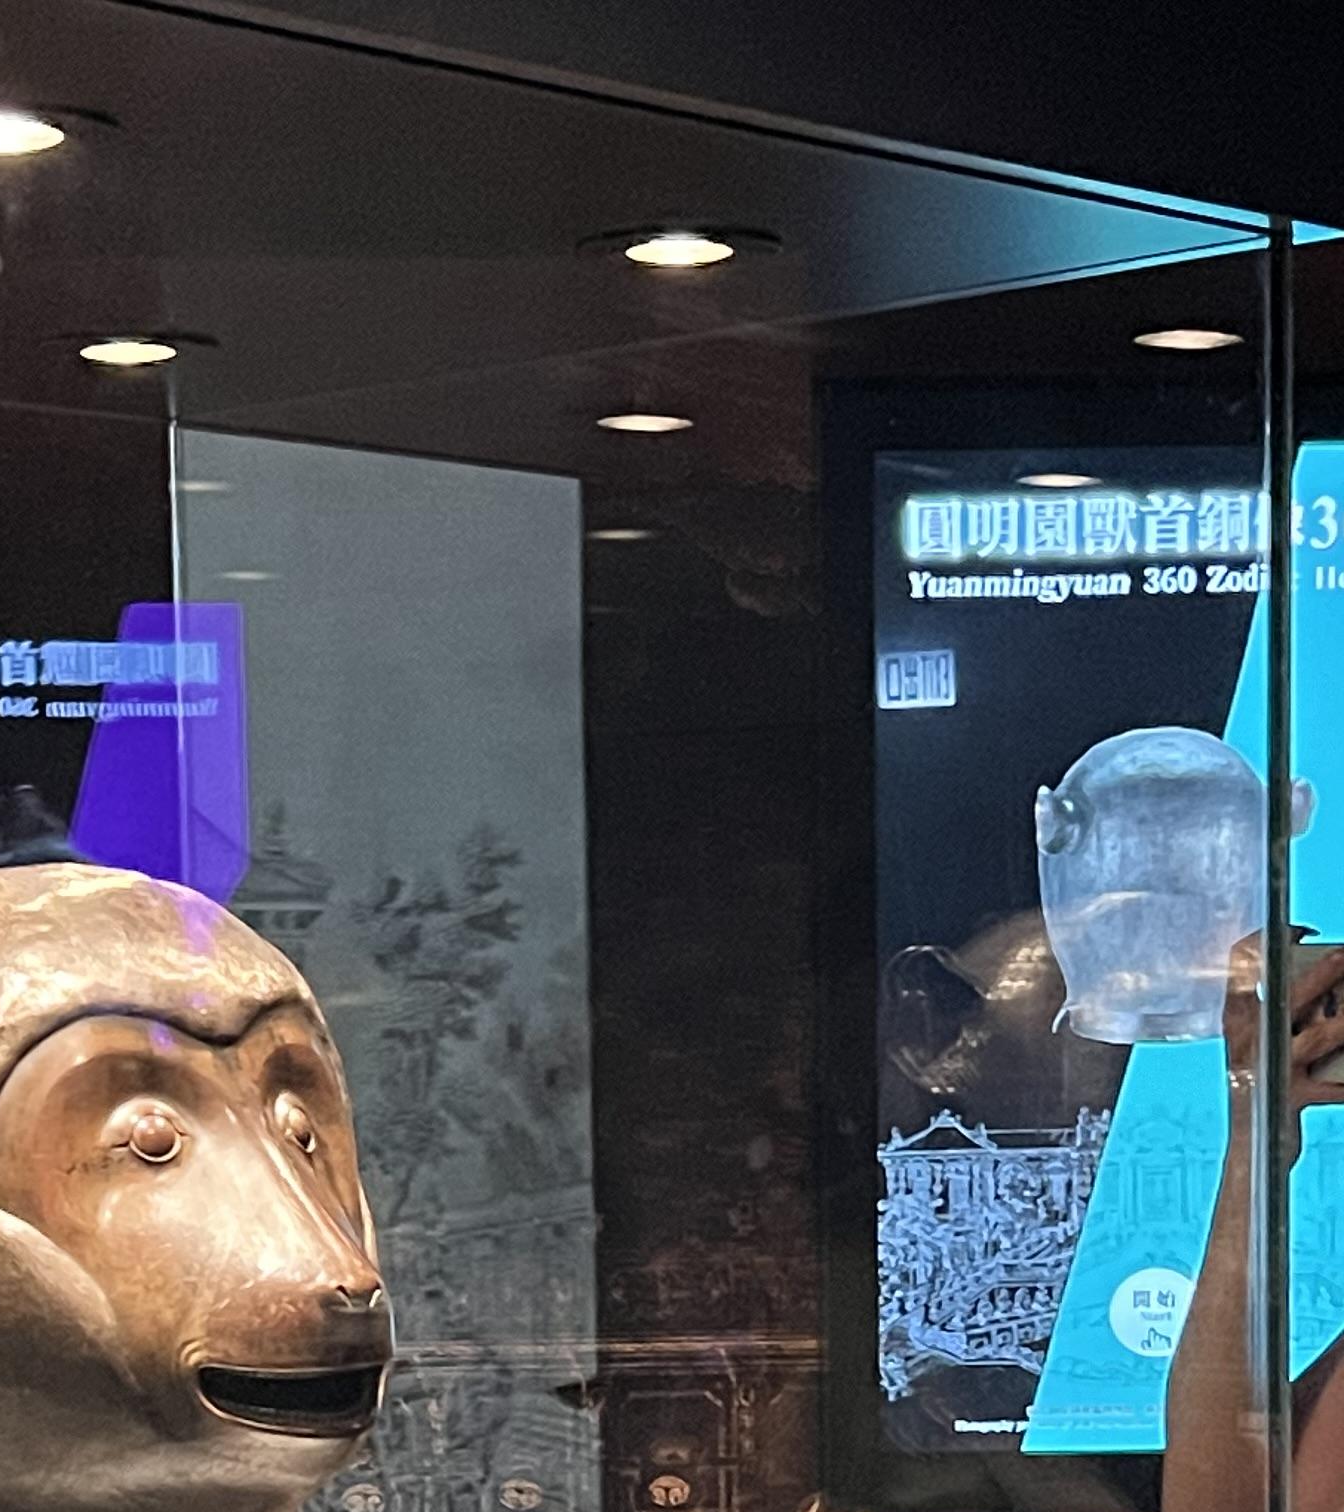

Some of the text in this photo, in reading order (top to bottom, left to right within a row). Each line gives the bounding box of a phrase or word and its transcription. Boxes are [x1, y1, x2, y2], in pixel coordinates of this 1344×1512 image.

[908, 570, 1131, 602] Yuanmingyuan
[1143, 567, 1197, 594] 360
[1206, 565, 1302, 594] Zodi
